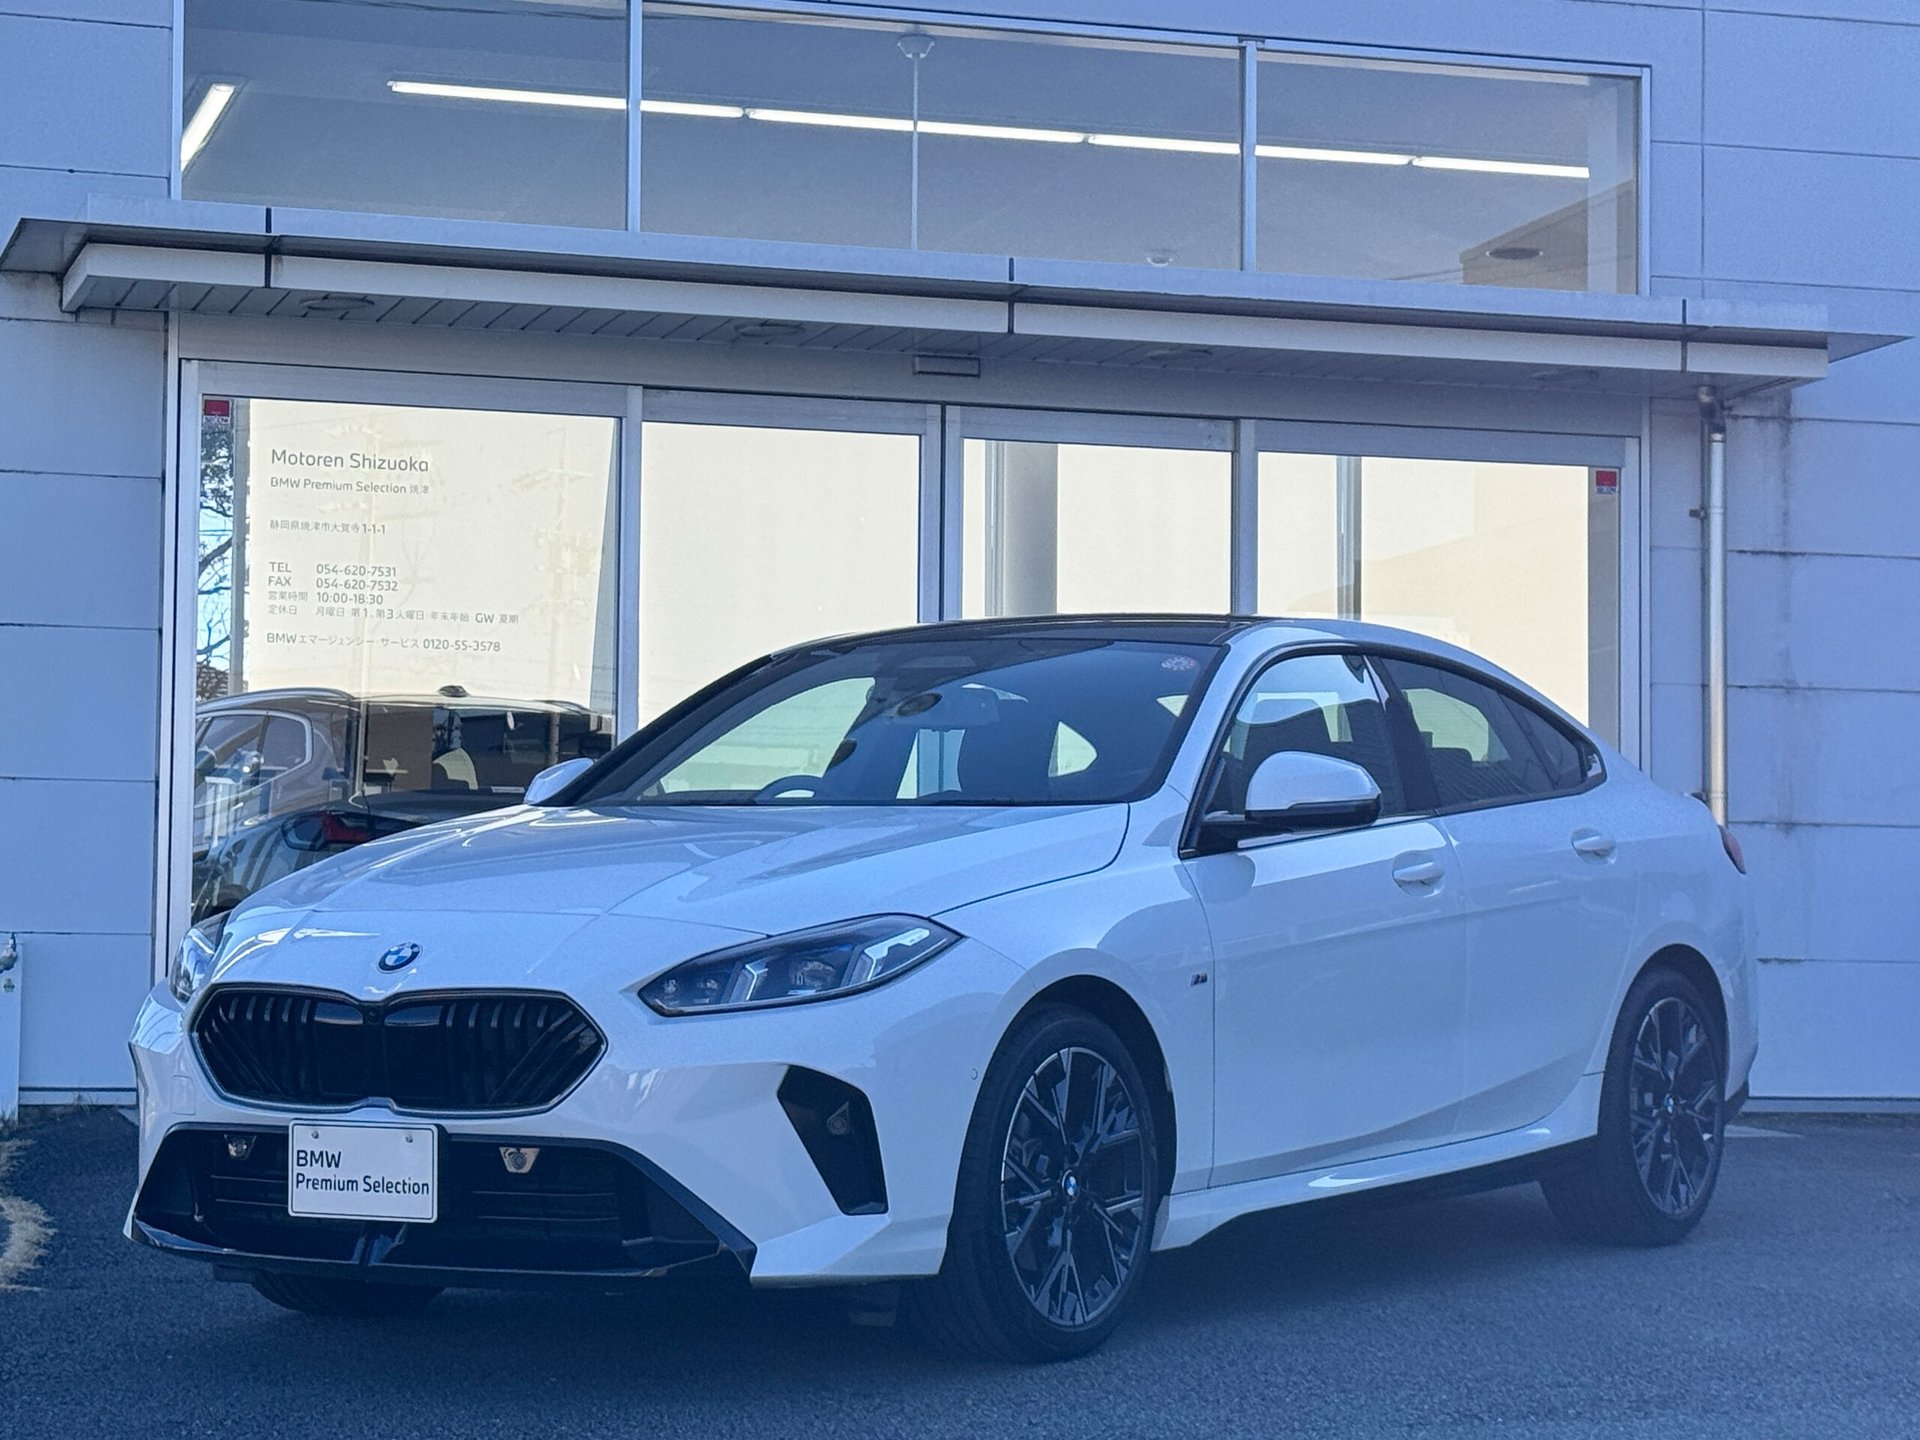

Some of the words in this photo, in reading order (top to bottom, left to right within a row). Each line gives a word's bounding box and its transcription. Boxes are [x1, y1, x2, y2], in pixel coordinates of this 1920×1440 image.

[271, 448, 344, 468] Motoren
[349, 453, 429, 472] Shizuoka
[270, 476, 301, 489] BMW
[303, 478, 353, 491] Premium
[355, 481, 407, 494] Selection
[268, 561, 292, 573] TEL
[316, 563, 396, 577] 054-620-7531
[268, 575, 292, 587] FAX
[316, 577, 398, 592] 054-620-7532
[267, 590, 308, 602] 営業時間
[316, 591, 384, 605] 10:00-18:30
[267, 603, 297, 615] 定休日
[475, 612, 495, 624] GW
[423, 638, 501, 652] 0120-55-3578
[296, 1149, 342, 1169] BMW
[296, 1172, 359, 1192] Premium
[362, 1175, 430, 1196] Selection
